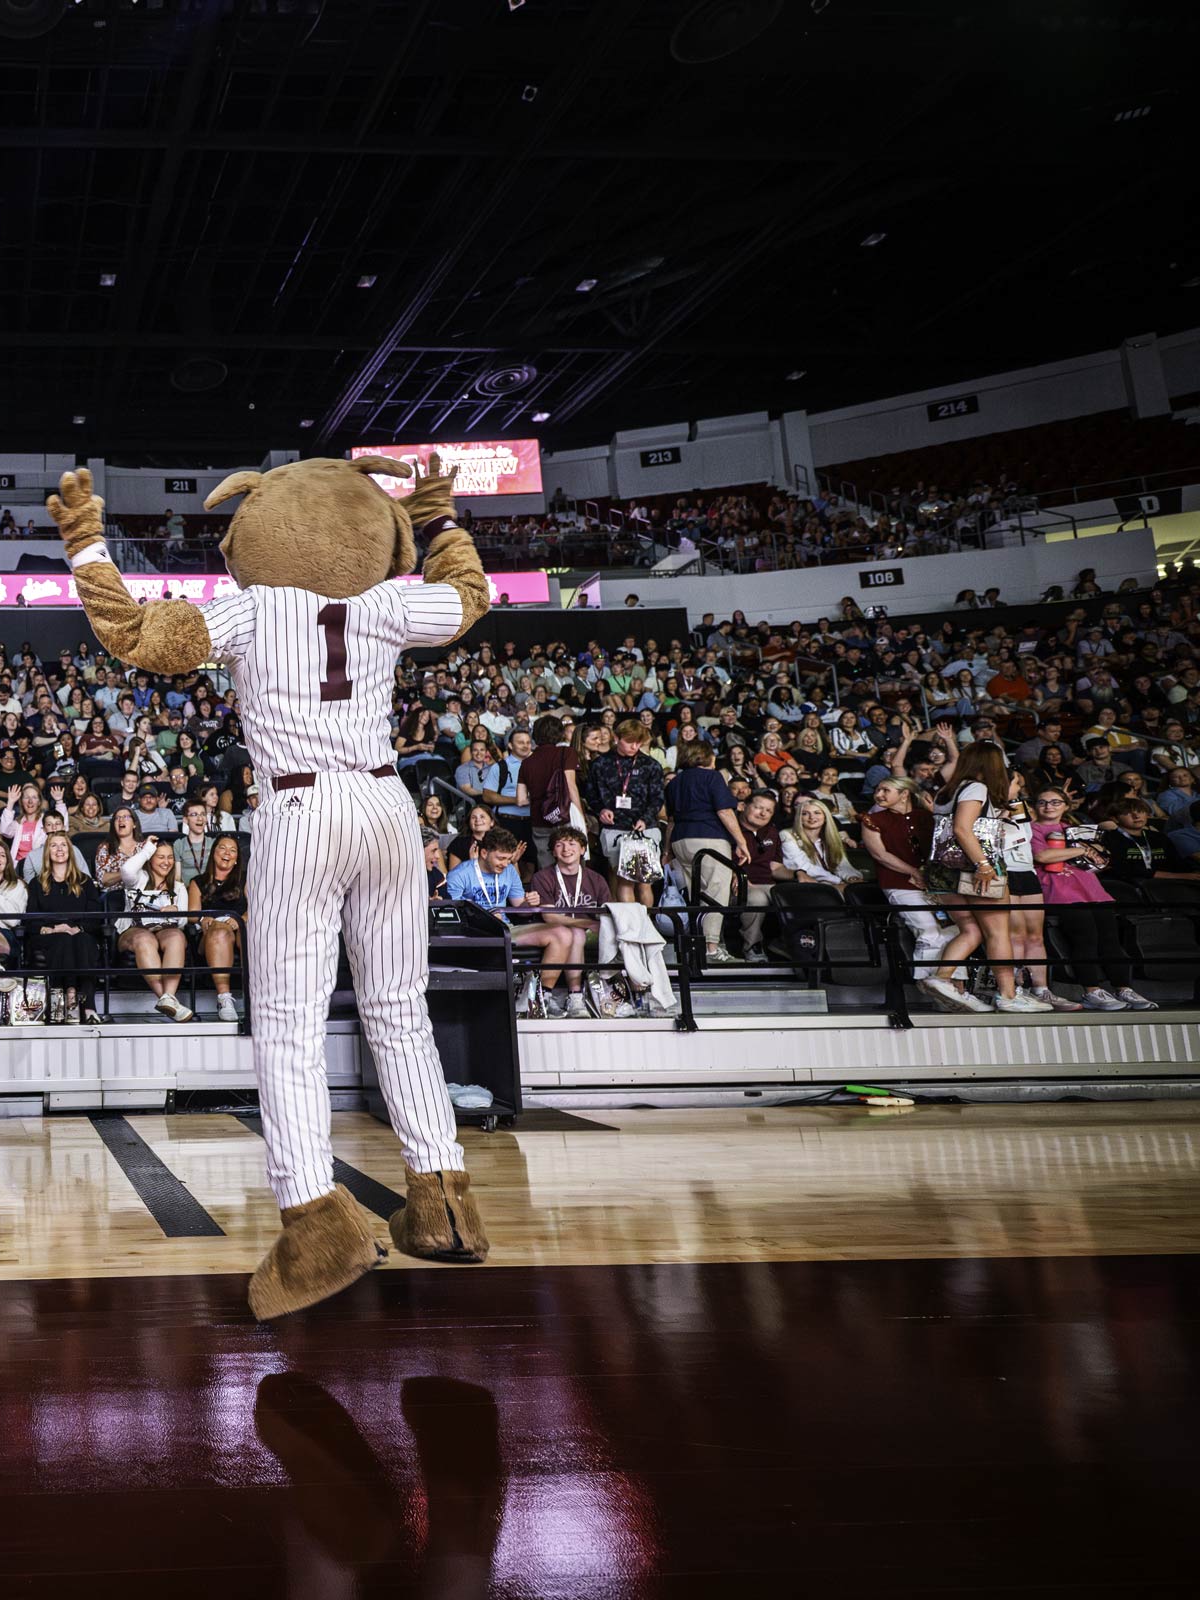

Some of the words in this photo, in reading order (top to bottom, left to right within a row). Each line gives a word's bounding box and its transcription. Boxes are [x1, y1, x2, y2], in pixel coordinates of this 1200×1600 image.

[937, 400, 968, 417] 214
[648, 450, 673, 464] 213
[172, 480, 189, 491] 211
[868, 571, 895, 586] 108
[317, 603, 353, 702] 1
